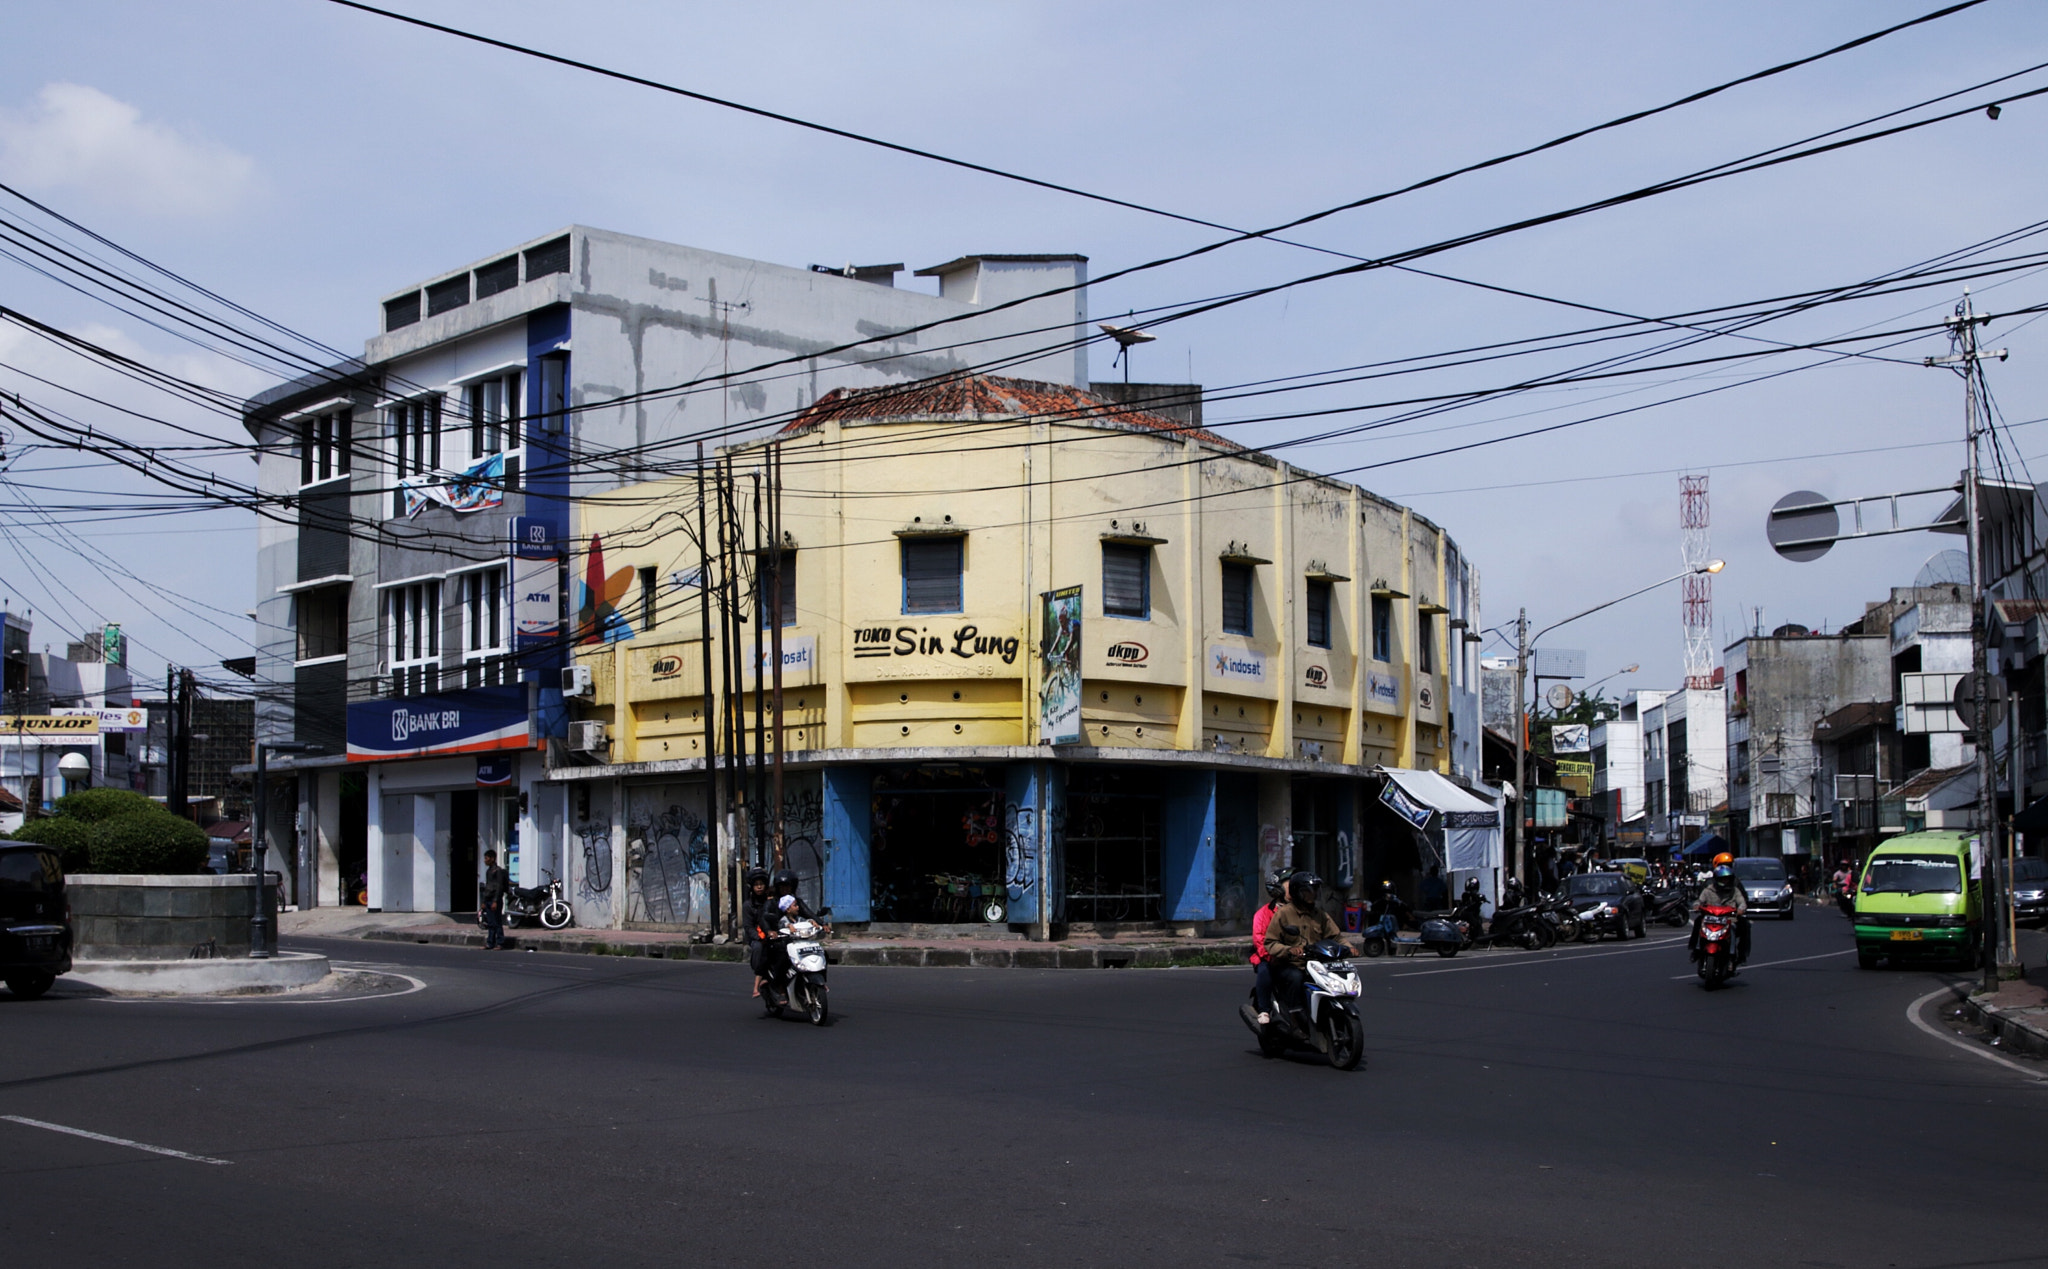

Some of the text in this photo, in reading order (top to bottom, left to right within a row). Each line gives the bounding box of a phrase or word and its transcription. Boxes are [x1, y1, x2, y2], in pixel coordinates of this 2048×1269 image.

[526, 593, 550, 603] ATM
[853, 625, 1020, 664] TOKO Sin Lung
[1107, 644, 1140, 660] dkpp
[769, 647, 807, 668] idosat
[652, 659, 676, 674] dkpp
[977, 664, 994, 676] 39
[1229, 658, 1261, 676] indosat
[1377, 682, 1397, 699] indosat
[10, 719, 93, 729] DUNLOP
[409, 710, 460, 733] BANK BRI
[478, 765, 493, 775] ATM
